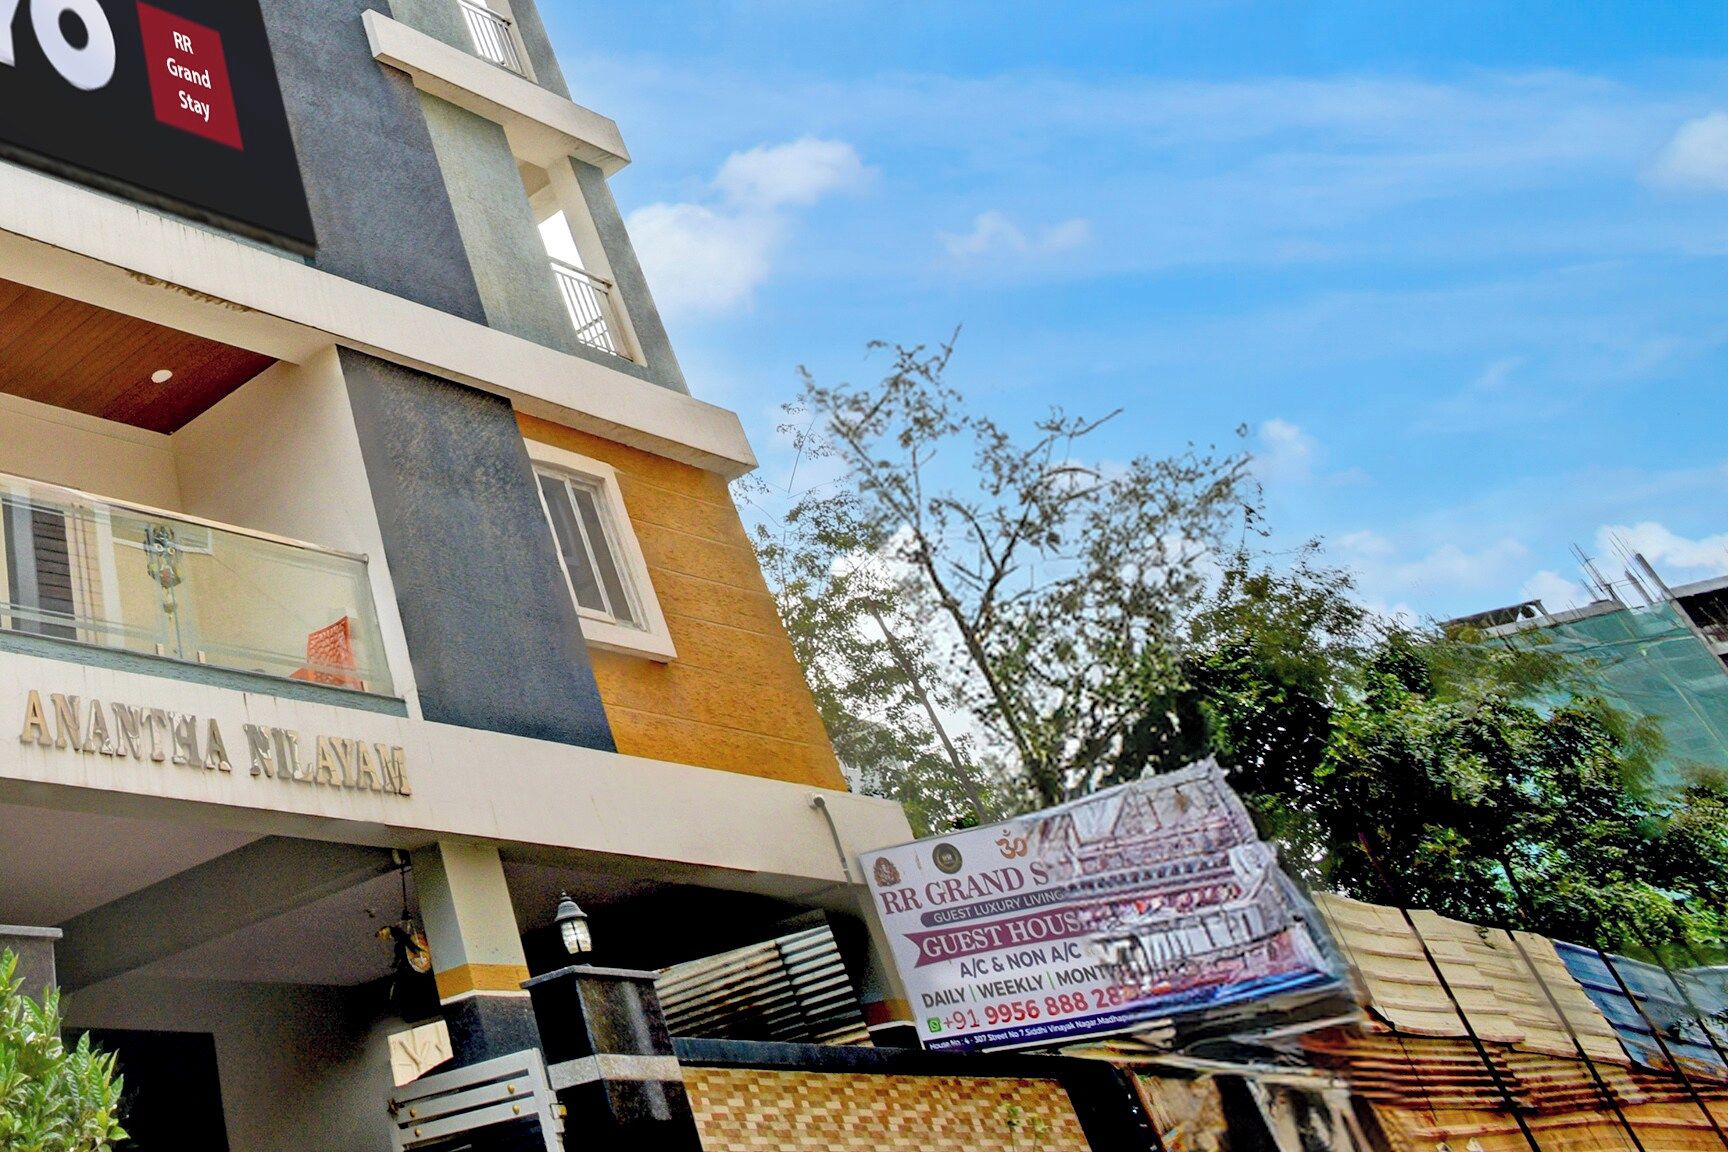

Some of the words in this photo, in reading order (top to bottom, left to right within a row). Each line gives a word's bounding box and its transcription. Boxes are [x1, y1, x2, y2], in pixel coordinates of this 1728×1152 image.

[173, 30, 194, 55] RR
[166, 57, 211, 90] Grand
[178, 89, 210, 123] Stay
[19, 689, 232, 773] ANANTHA
[243, 723, 413, 797] NILAYAM
[879, 887, 923, 915] RR
[925, 866, 1025, 906] GRAND
[933, 908, 972, 924] GUEST
[974, 898, 1020, 915] LUXURY
[1024, 889, 1065, 907] LIVING
[921, 926, 1003, 958] GUEST
[960, 957, 989, 979] A/C
[992, 956, 1005, 972] &
[1006, 948, 1046, 970] NON
[1051, 942, 1083, 964] A/C
[921, 986, 967, 1008] DAILY
[976, 975, 1044, 999] WEEKLY
[943, 1008, 980, 1030] +91
[984, 999, 1041, 1025] 9956
[1044, 991, 1089, 1016] 888
[1091, 986, 1122, 1009] 28
